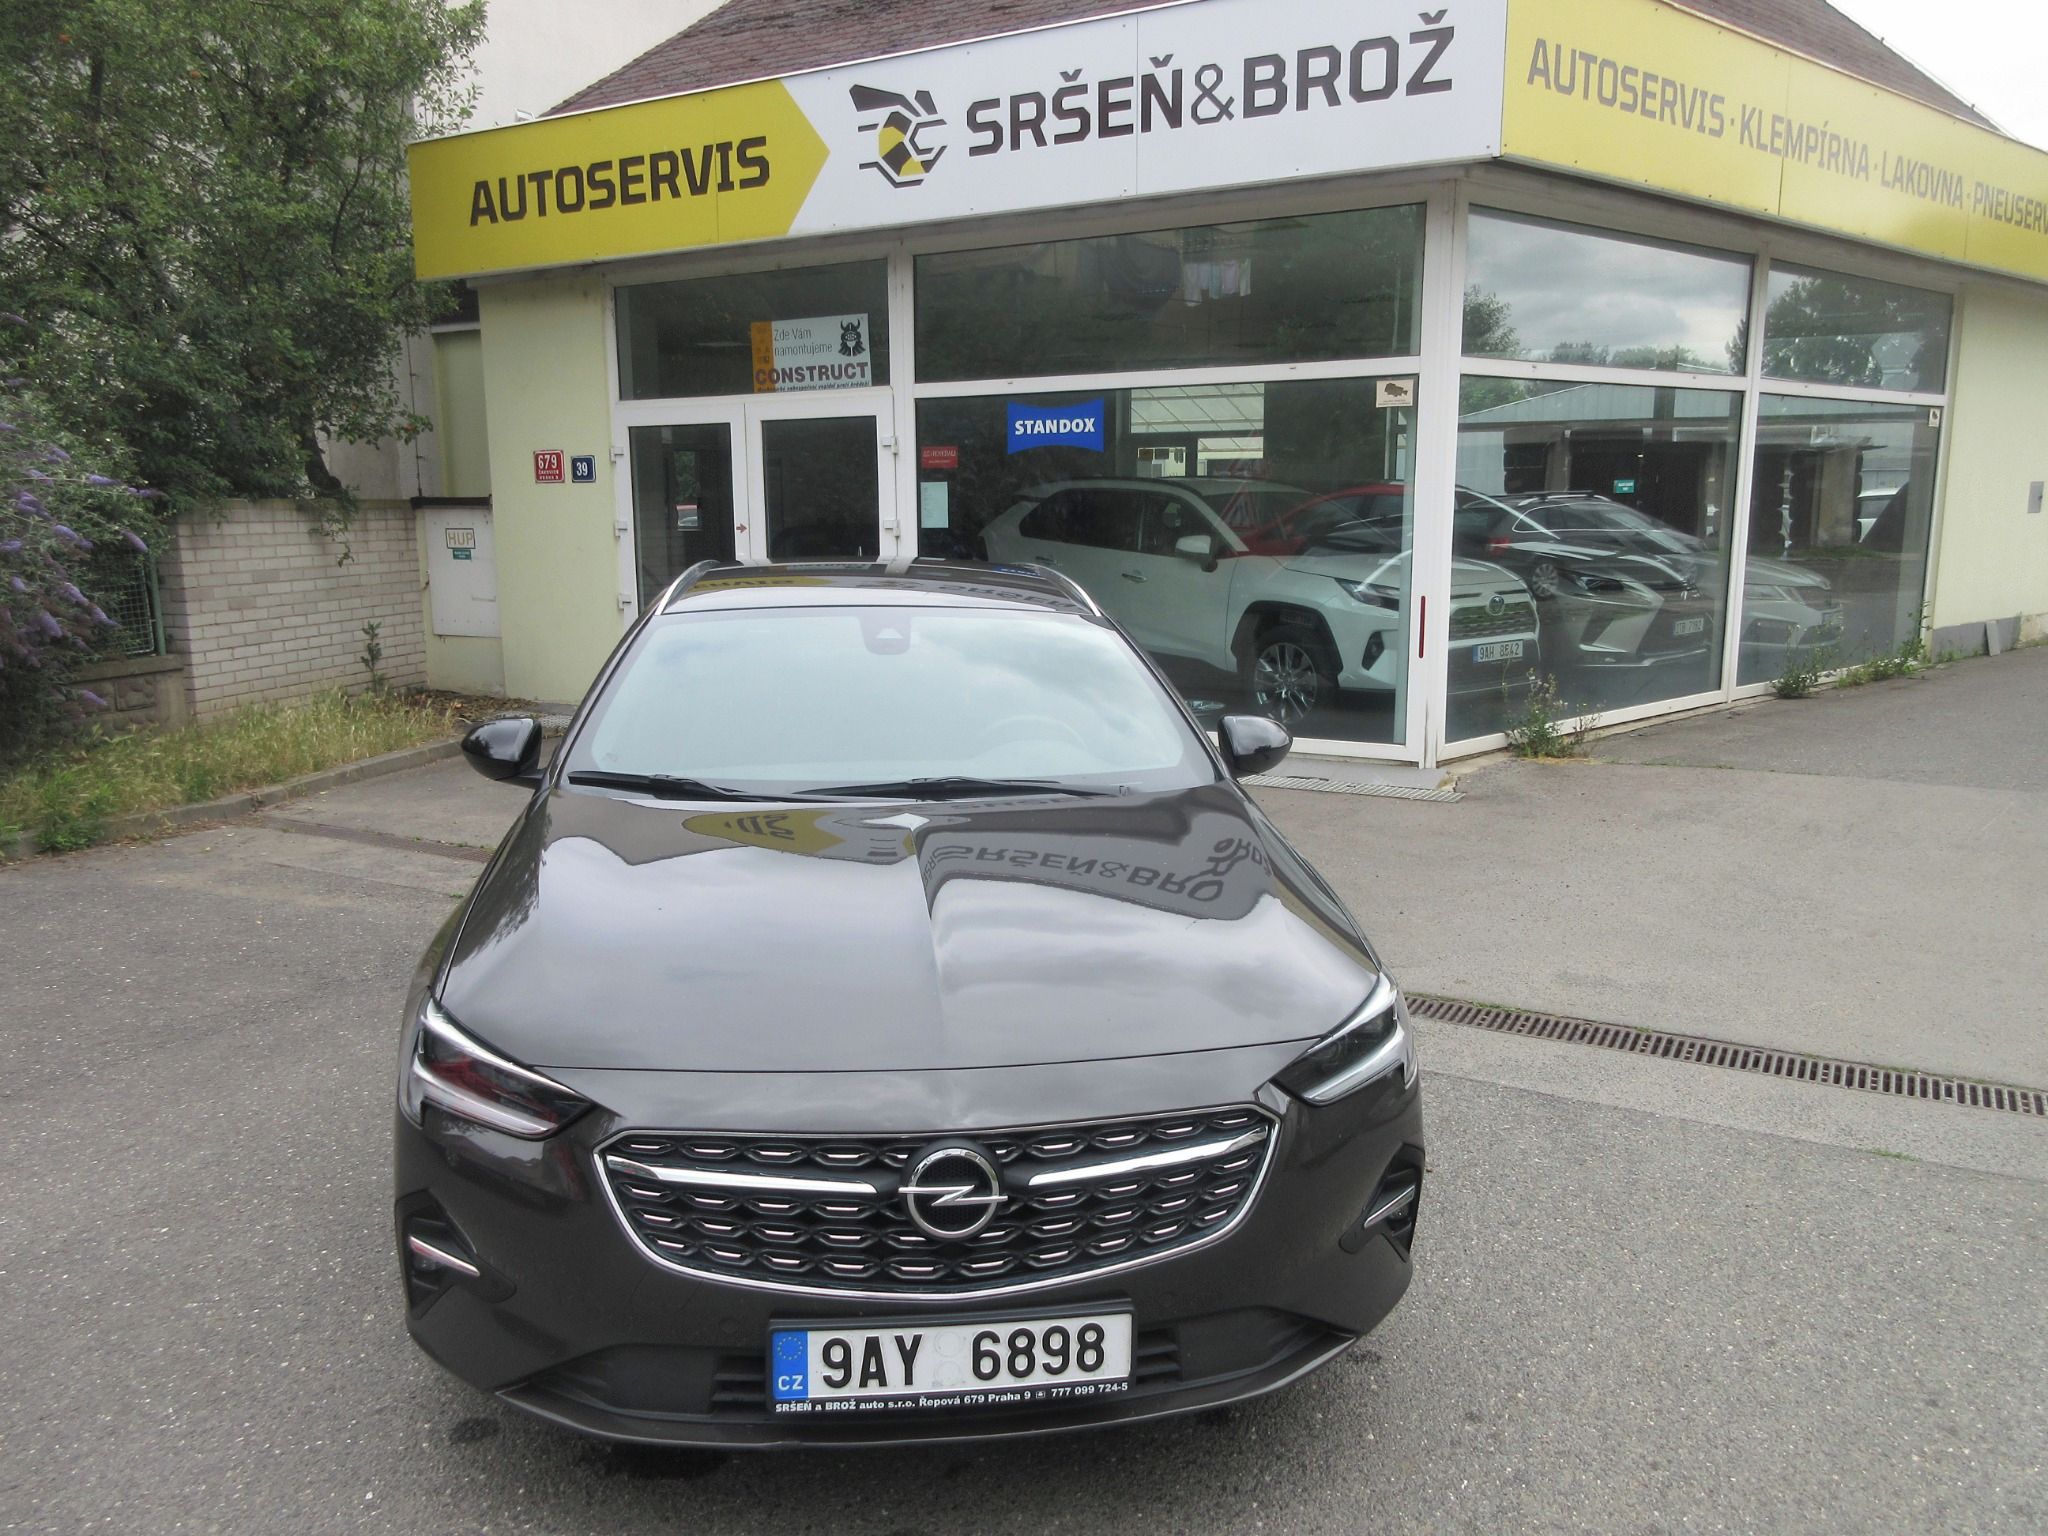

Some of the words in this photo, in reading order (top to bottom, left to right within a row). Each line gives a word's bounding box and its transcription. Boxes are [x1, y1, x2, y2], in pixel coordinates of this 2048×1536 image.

[966, 9, 1455, 157] SRŠEŇ&BROŽ
[1527, 38, 1726, 138] AUTOSERVIS
[1738, 102, 1870, 182] KLEMPÍRNA
[1880, 150, 1963, 210] LAKOVNA
[469, 136, 771, 227] AUTOSERVIS
[774, 328, 789, 342] Zde
[791, 327, 812, 340] Vám
[774, 342, 833, 357] namontujeme
[755, 361, 869, 385] CONSTRUCT
[1015, 417, 1096, 436] STANDOX
[538, 454, 557, 470] 679
[576, 461, 588, 476] 39
[447, 531, 473, 546] HUP
[822, 1332, 924, 1389] 9AY
[971, 1322, 1105, 1381] 6898
[777, 1375, 803, 1391] CZ
[775, 1400, 812, 1413] SRŠEŇ
[815, 1403, 822, 1411] a
[825, 1398, 856, 1411] BROŽ
[859, 1400, 885, 1409] auto
[888, 1400, 916, 1408] s.r.o.
[919, 1395, 961, 1408] Řepová
[964, 1394, 985, 1404] 679
[988, 1392, 1021, 1403] Praha
[1024, 1391, 1031, 1400] 9
[1051, 1387, 1071, 1398] 777
[1075, 1385, 1095, 1395] 099
[1098, 1382, 1129, 1393] 724-5
